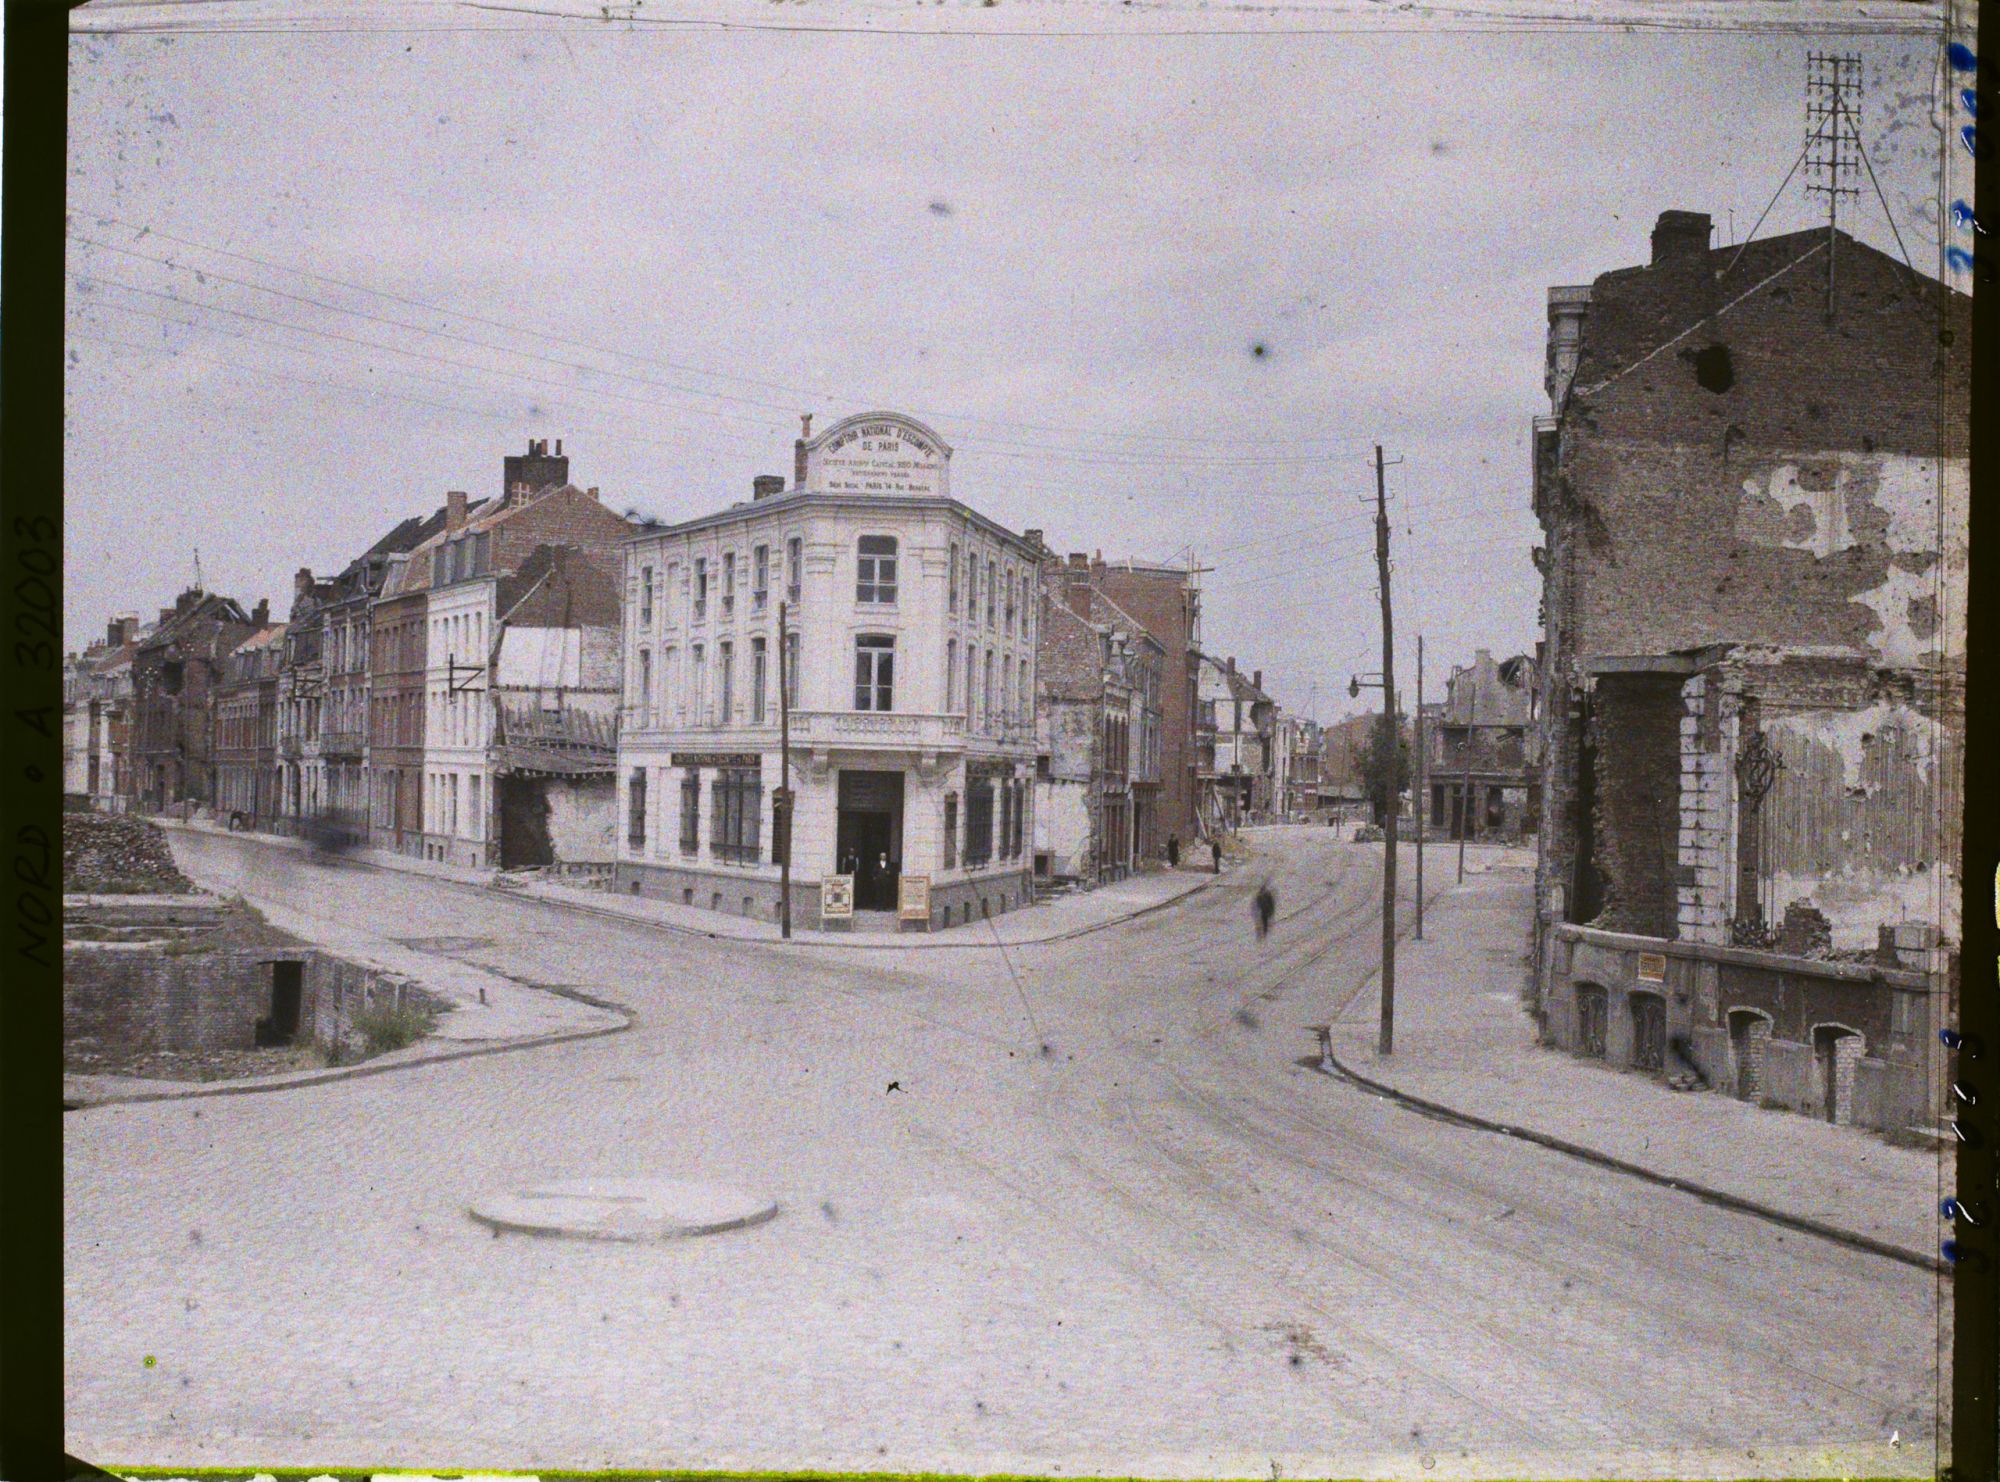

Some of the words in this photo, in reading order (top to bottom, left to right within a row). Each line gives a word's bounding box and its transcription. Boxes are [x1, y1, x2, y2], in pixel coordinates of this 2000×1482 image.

[828, 430, 859, 454] COMPTOIR
[861, 424, 892, 437] NATIONAL
[896, 427, 935, 458] D'ESCOMPTE
[862, 441, 873, 451] DE
[878, 441, 900, 452] PARIS
[13, 514, 59, 671] 32003
[15, 706, 53, 738] A
[13, 824, 53, 967] NORD
